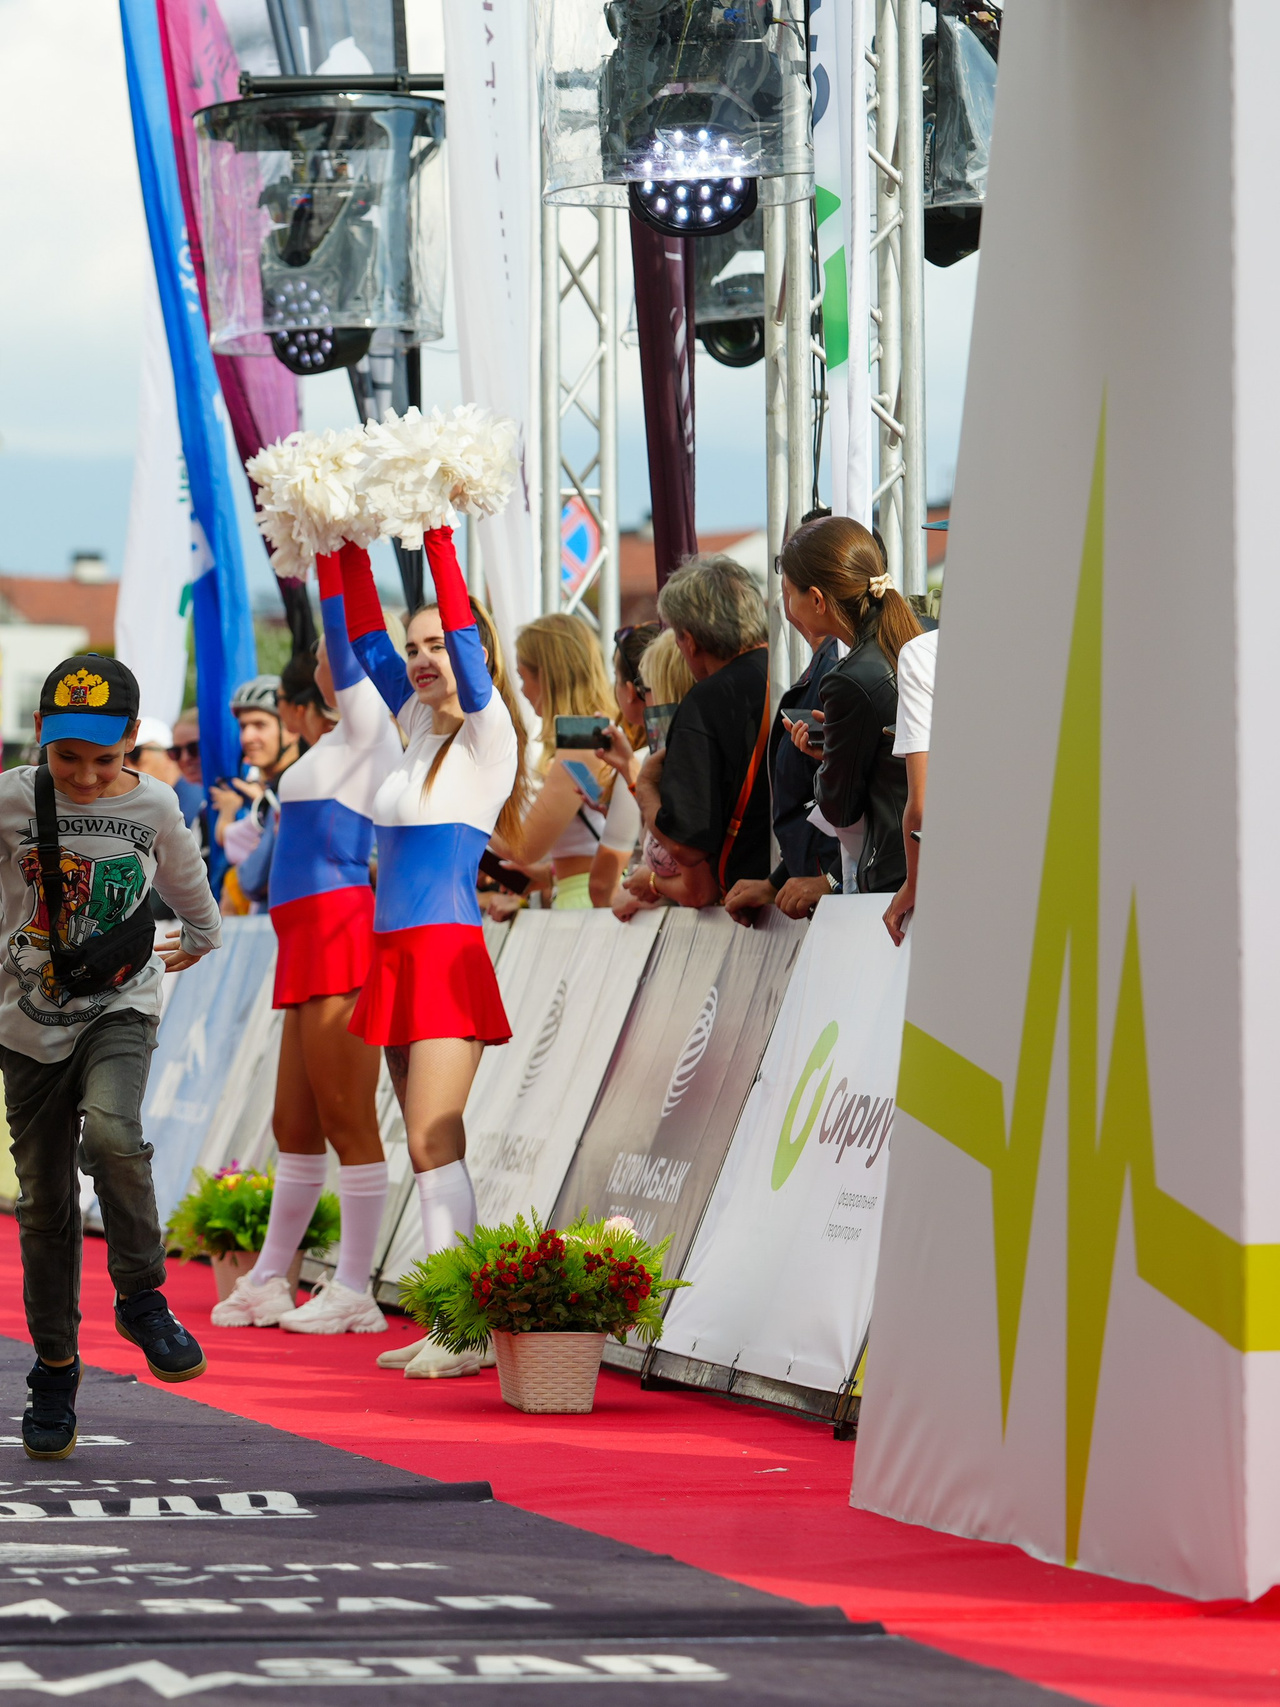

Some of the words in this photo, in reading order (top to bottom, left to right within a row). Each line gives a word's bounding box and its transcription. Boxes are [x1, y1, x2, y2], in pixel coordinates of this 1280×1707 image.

[56, 819, 152, 844] OGWARTS
[21, 1000, 60, 1023] DORMIENS
[819, 1077, 895, 1169] Сириу
[605, 1151, 692, 1204] ГАЗПРОМБАНК
[136, 1594, 554, 1615] STAR
[256, 1653, 718, 1677] STAR
